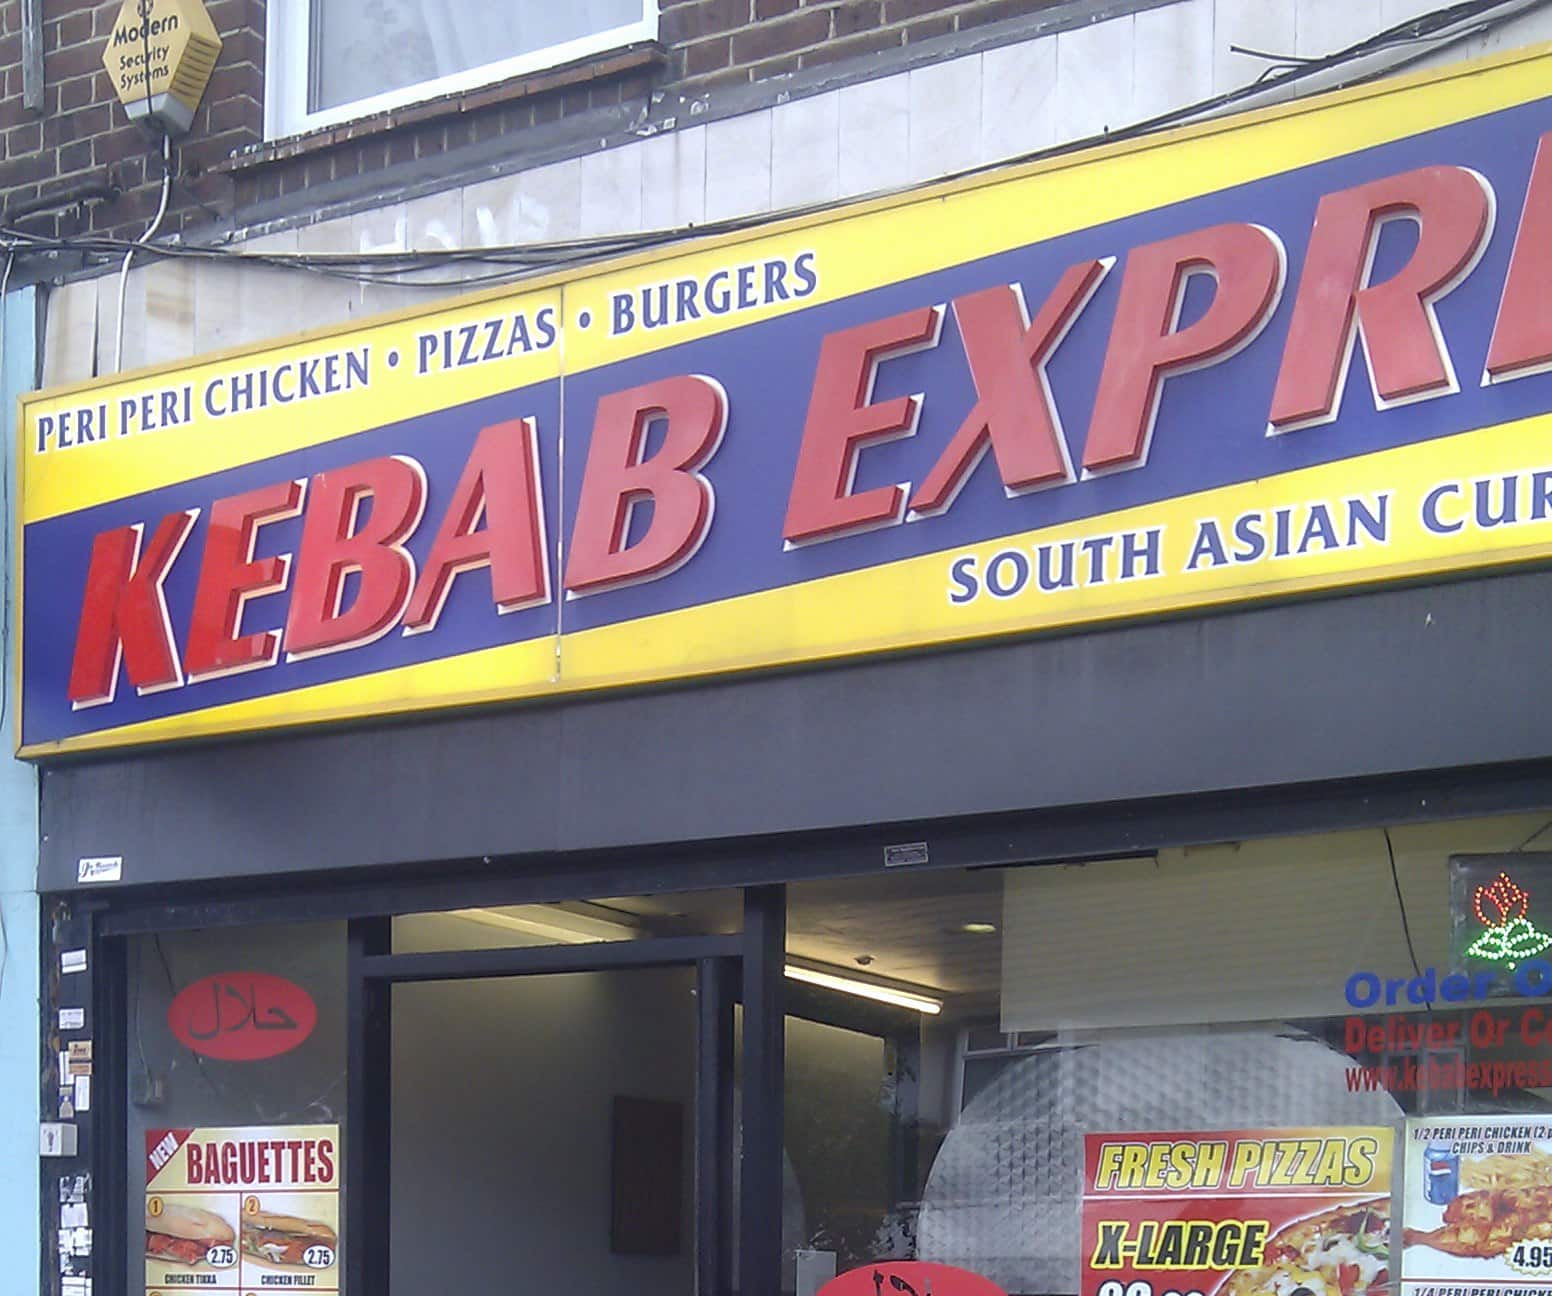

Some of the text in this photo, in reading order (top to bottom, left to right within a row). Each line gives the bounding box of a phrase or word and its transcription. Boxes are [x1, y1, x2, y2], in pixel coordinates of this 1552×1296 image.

[113, 14, 178, 48] Modern
[120, 45, 170, 71] Security
[38, 252, 818, 452] PERI PERI CHICKEN PIZZAS BURGERS
[67, 373, 730, 711] KEBAB
[950, 529, 1162, 604] SOUTH
[1187, 494, 1389, 571] ASIAN
[1345, 967, 1497, 1008] Order
[188, 981, 299, 1041] حلال
[1344, 1013, 1461, 1055] Deliver
[1470, 1009, 1511, 1049] Or
[149, 1131, 180, 1171] NEW
[1414, 1127, 1431, 1140] 1/2
[1432, 1127, 1455, 1140] PERI
[1458, 1126, 1481, 1139] PERI
[1483, 1126, 1531, 1139] CHICKEN
[1452, 1141, 1485, 1154] CHIPS
[1497, 1141, 1532, 1154] DRINK
[186, 1139, 335, 1185] BAGUETTES
[1095, 1136, 1379, 1190] FRESH PIZZAS
[210, 1248, 233, 1266] 2.75
[307, 1248, 331, 1266] 2.75
[1090, 1220, 1270, 1270] X-LARGE
[1513, 1246, 1552, 1268] 4.95
[165, 1274, 194, 1285] CHICKEN
[261, 1275, 316, 1287] CHICKEN FILLET
